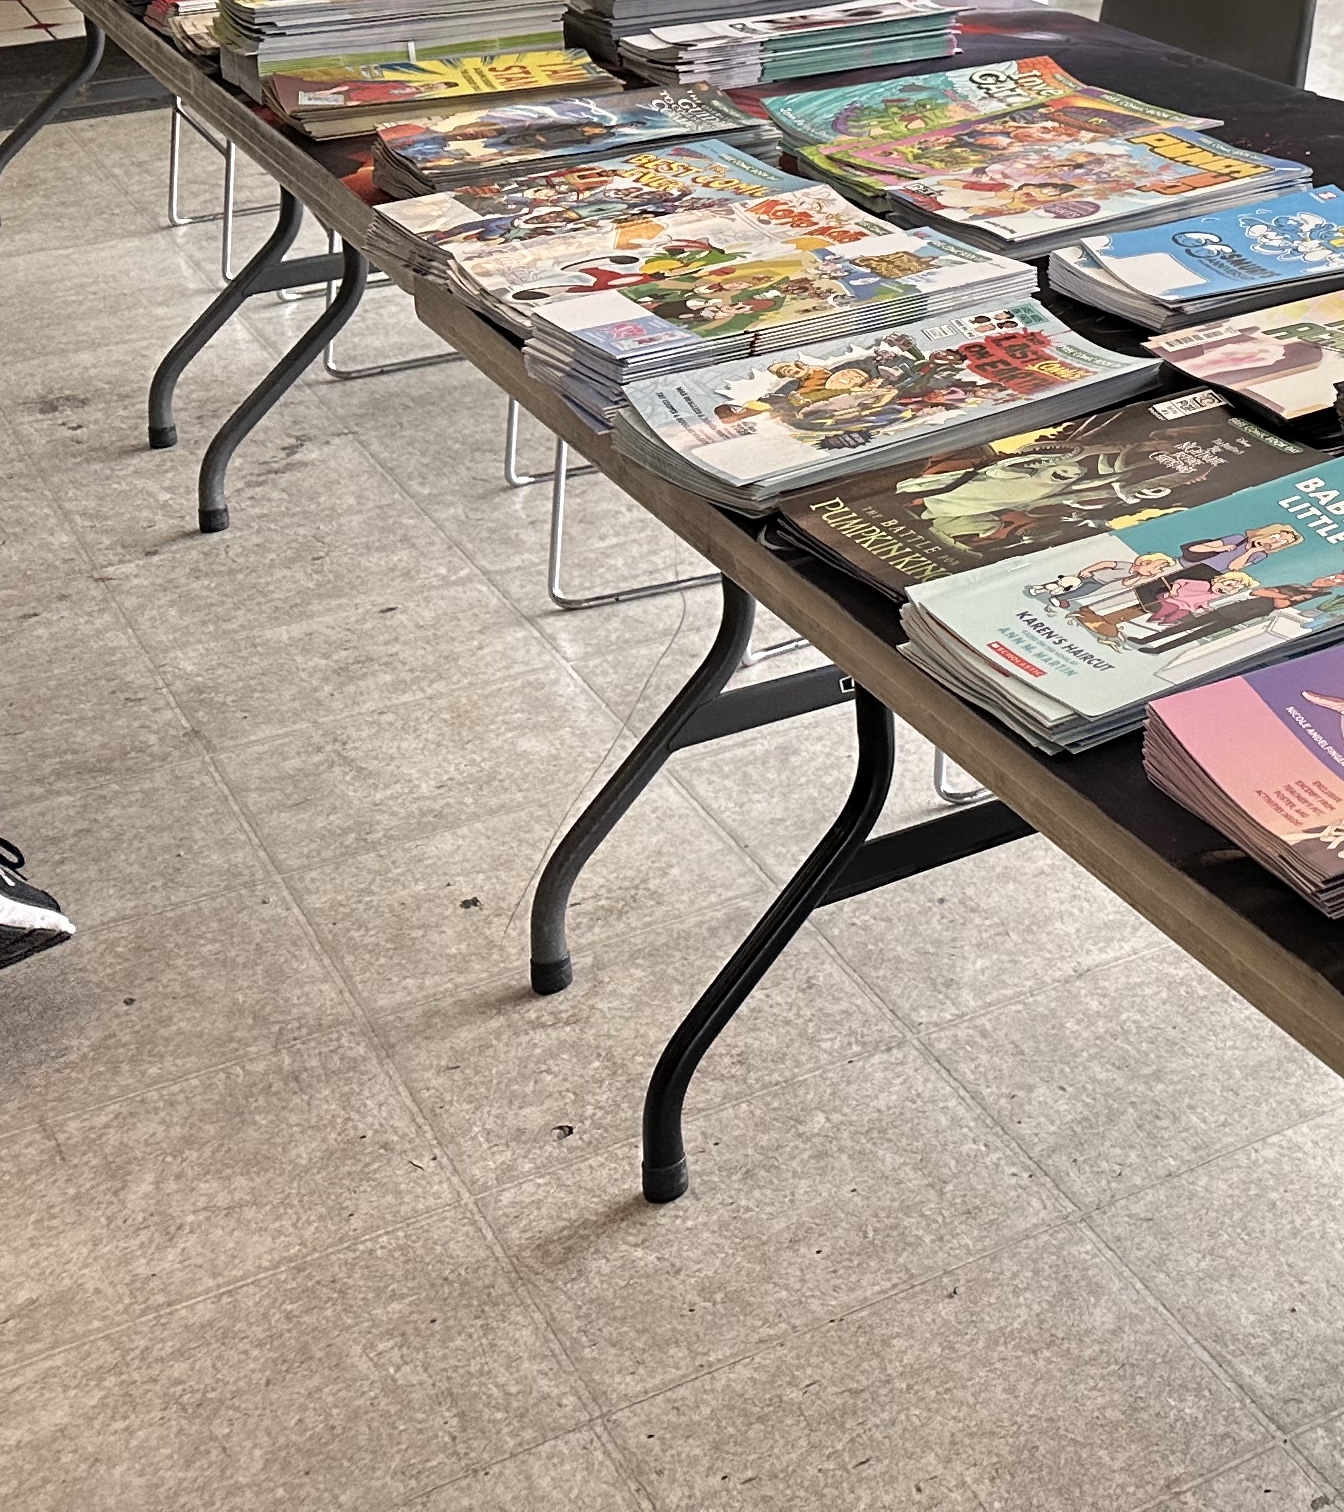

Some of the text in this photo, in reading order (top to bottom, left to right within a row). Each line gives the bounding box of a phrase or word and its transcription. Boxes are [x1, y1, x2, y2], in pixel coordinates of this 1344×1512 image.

[1016, 69, 1064, 98] Inve
[624, 154, 702, 178] BEST
[810, 496, 902, 560] PUMPKIN
[862, 505, 884, 520] THE
[880, 518, 942, 554] BATTLE
[997, 626, 1026, 645] ANN
[1033, 651, 1080, 677] MARTIN
[1016, 610, 1068, 646] KAREN'S
[1061, 642, 1116, 672] HAIRCUT
[1286, 705, 1311, 732] NICOLE
